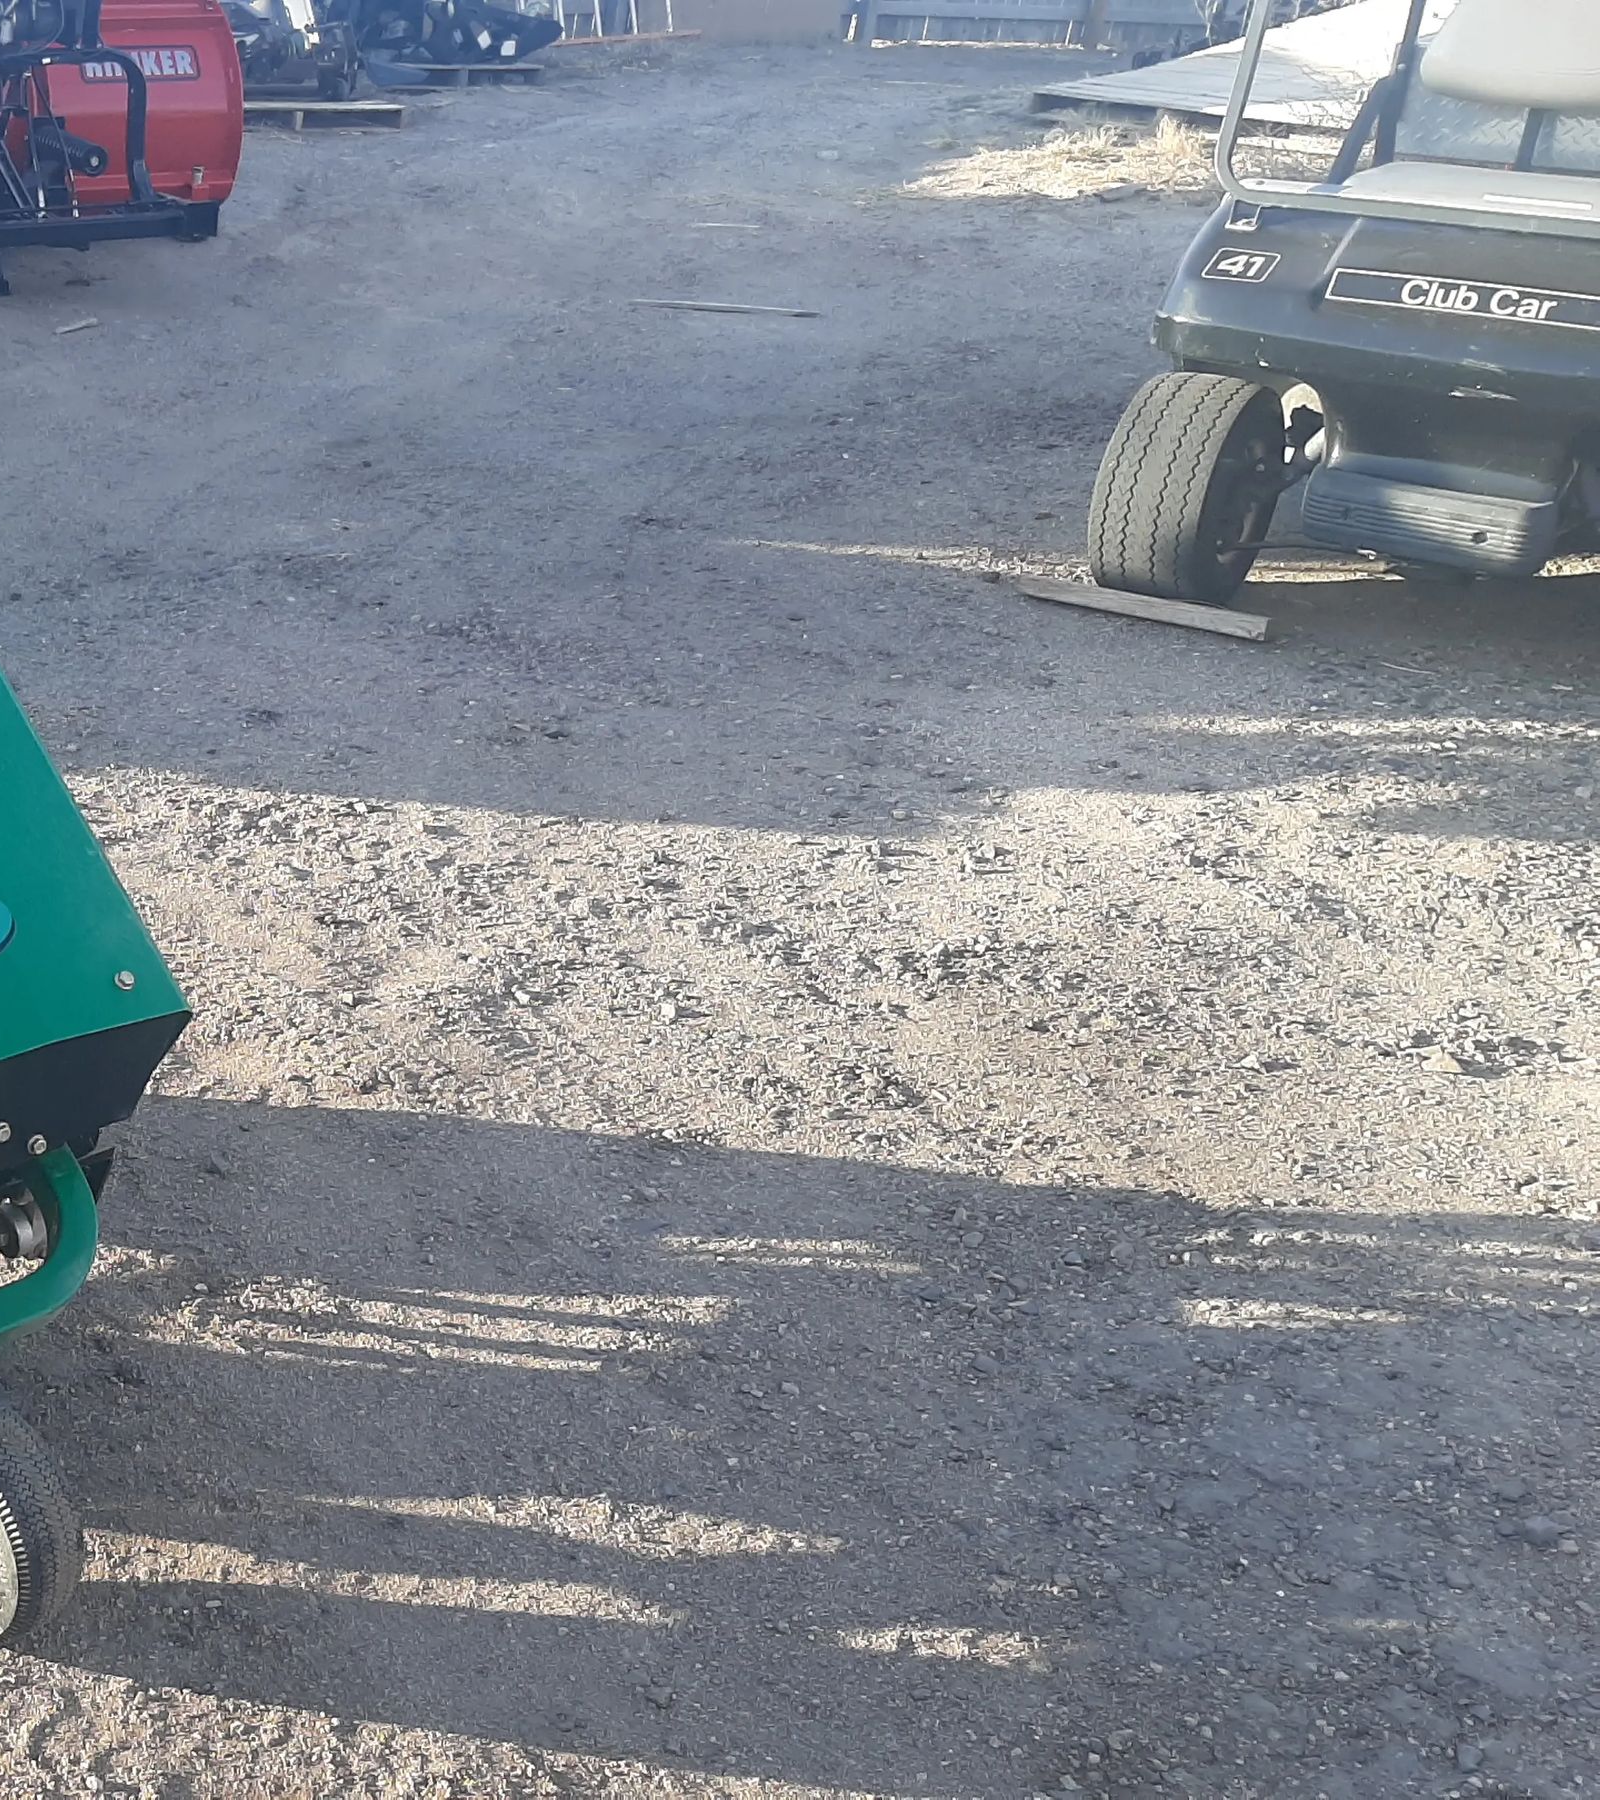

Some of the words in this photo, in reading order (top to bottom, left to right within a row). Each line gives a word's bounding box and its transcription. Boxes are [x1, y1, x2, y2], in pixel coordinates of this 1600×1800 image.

[1216, 253, 1267, 279] 41
[1400, 279, 1479, 311] Club
[1488, 289, 1559, 320] Car
